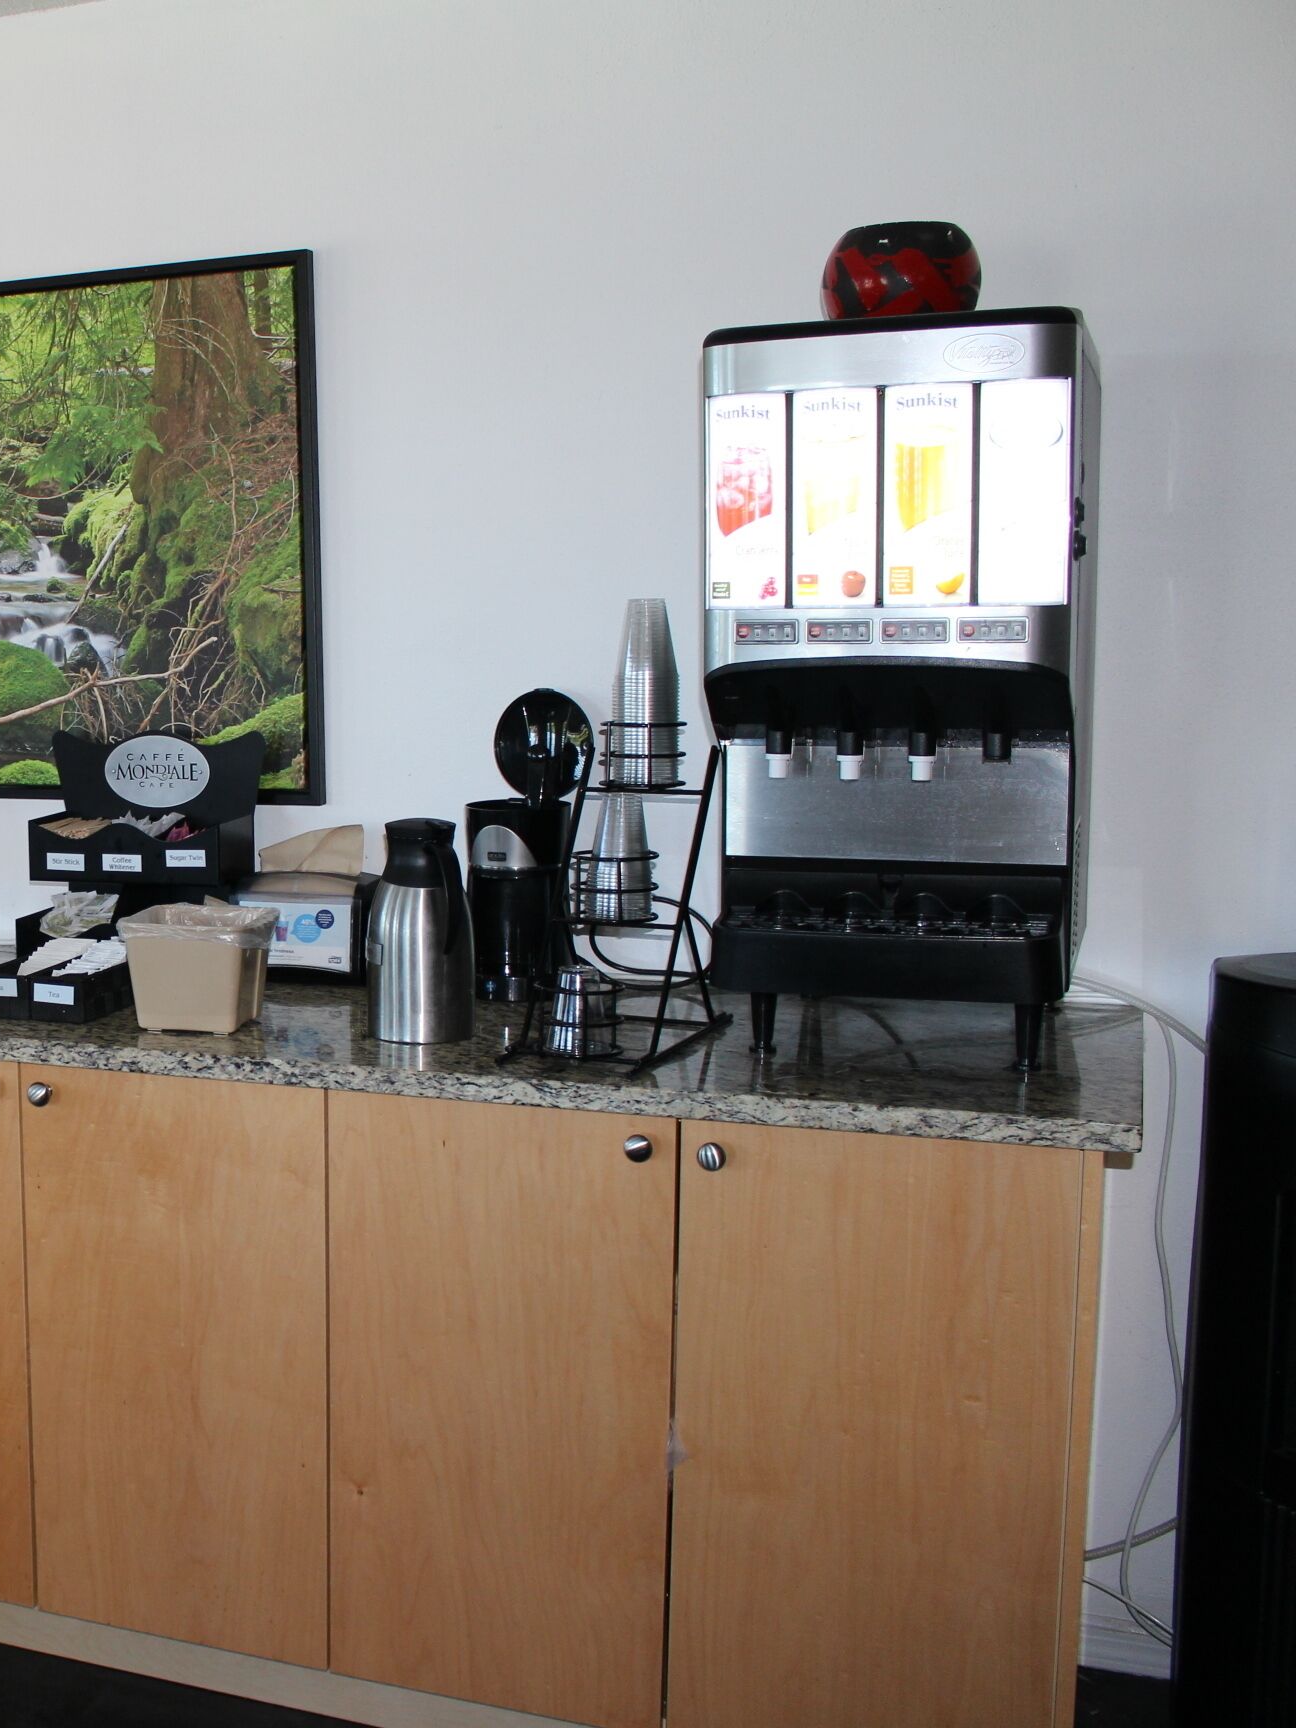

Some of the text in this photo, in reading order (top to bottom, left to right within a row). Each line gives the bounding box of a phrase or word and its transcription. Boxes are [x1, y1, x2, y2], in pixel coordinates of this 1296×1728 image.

[802, 396, 863, 413] Sunkist
[895, 392, 959, 410] Sunkist
[716, 404, 771, 421] Sunkist
[116, 763, 199, 782] MONDIALE
[138, 781, 175, 789] CAFE
[64, 858, 81, 866] Stick
[169, 854, 187, 862] Sugar
[108, 863, 136, 871] Whitener
